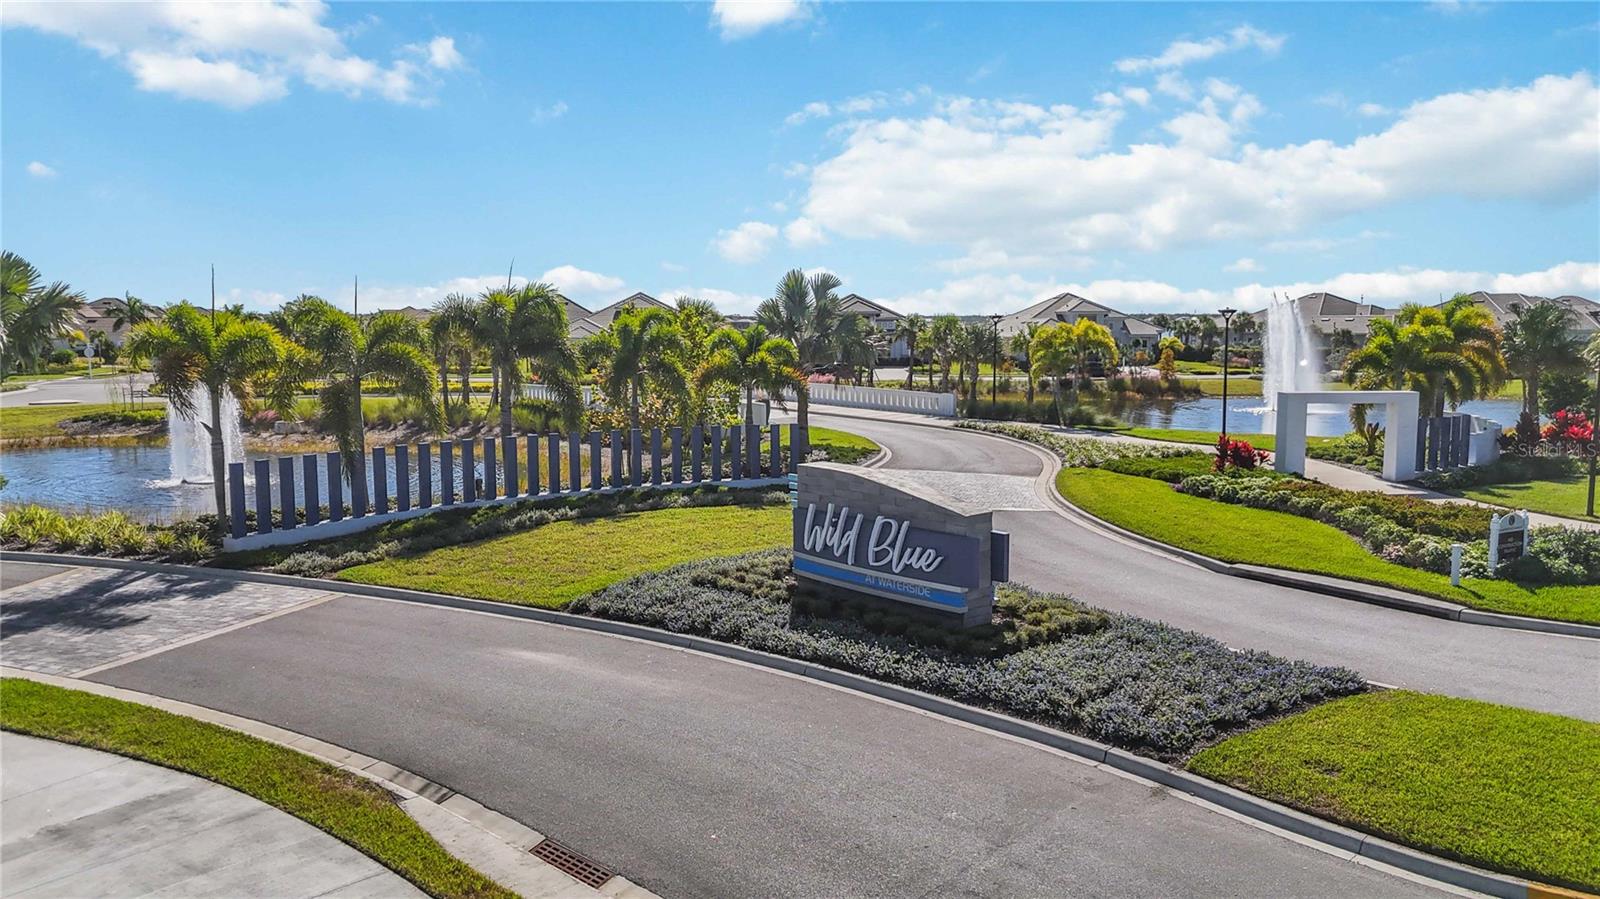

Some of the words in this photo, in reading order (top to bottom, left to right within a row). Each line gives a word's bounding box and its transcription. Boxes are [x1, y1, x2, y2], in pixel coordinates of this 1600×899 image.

[803, 503, 864, 565] Wild
[868, 515, 945, 574] Blue
[865, 575, 876, 585] AT
[878, 577, 931, 597] WATERSIDE
